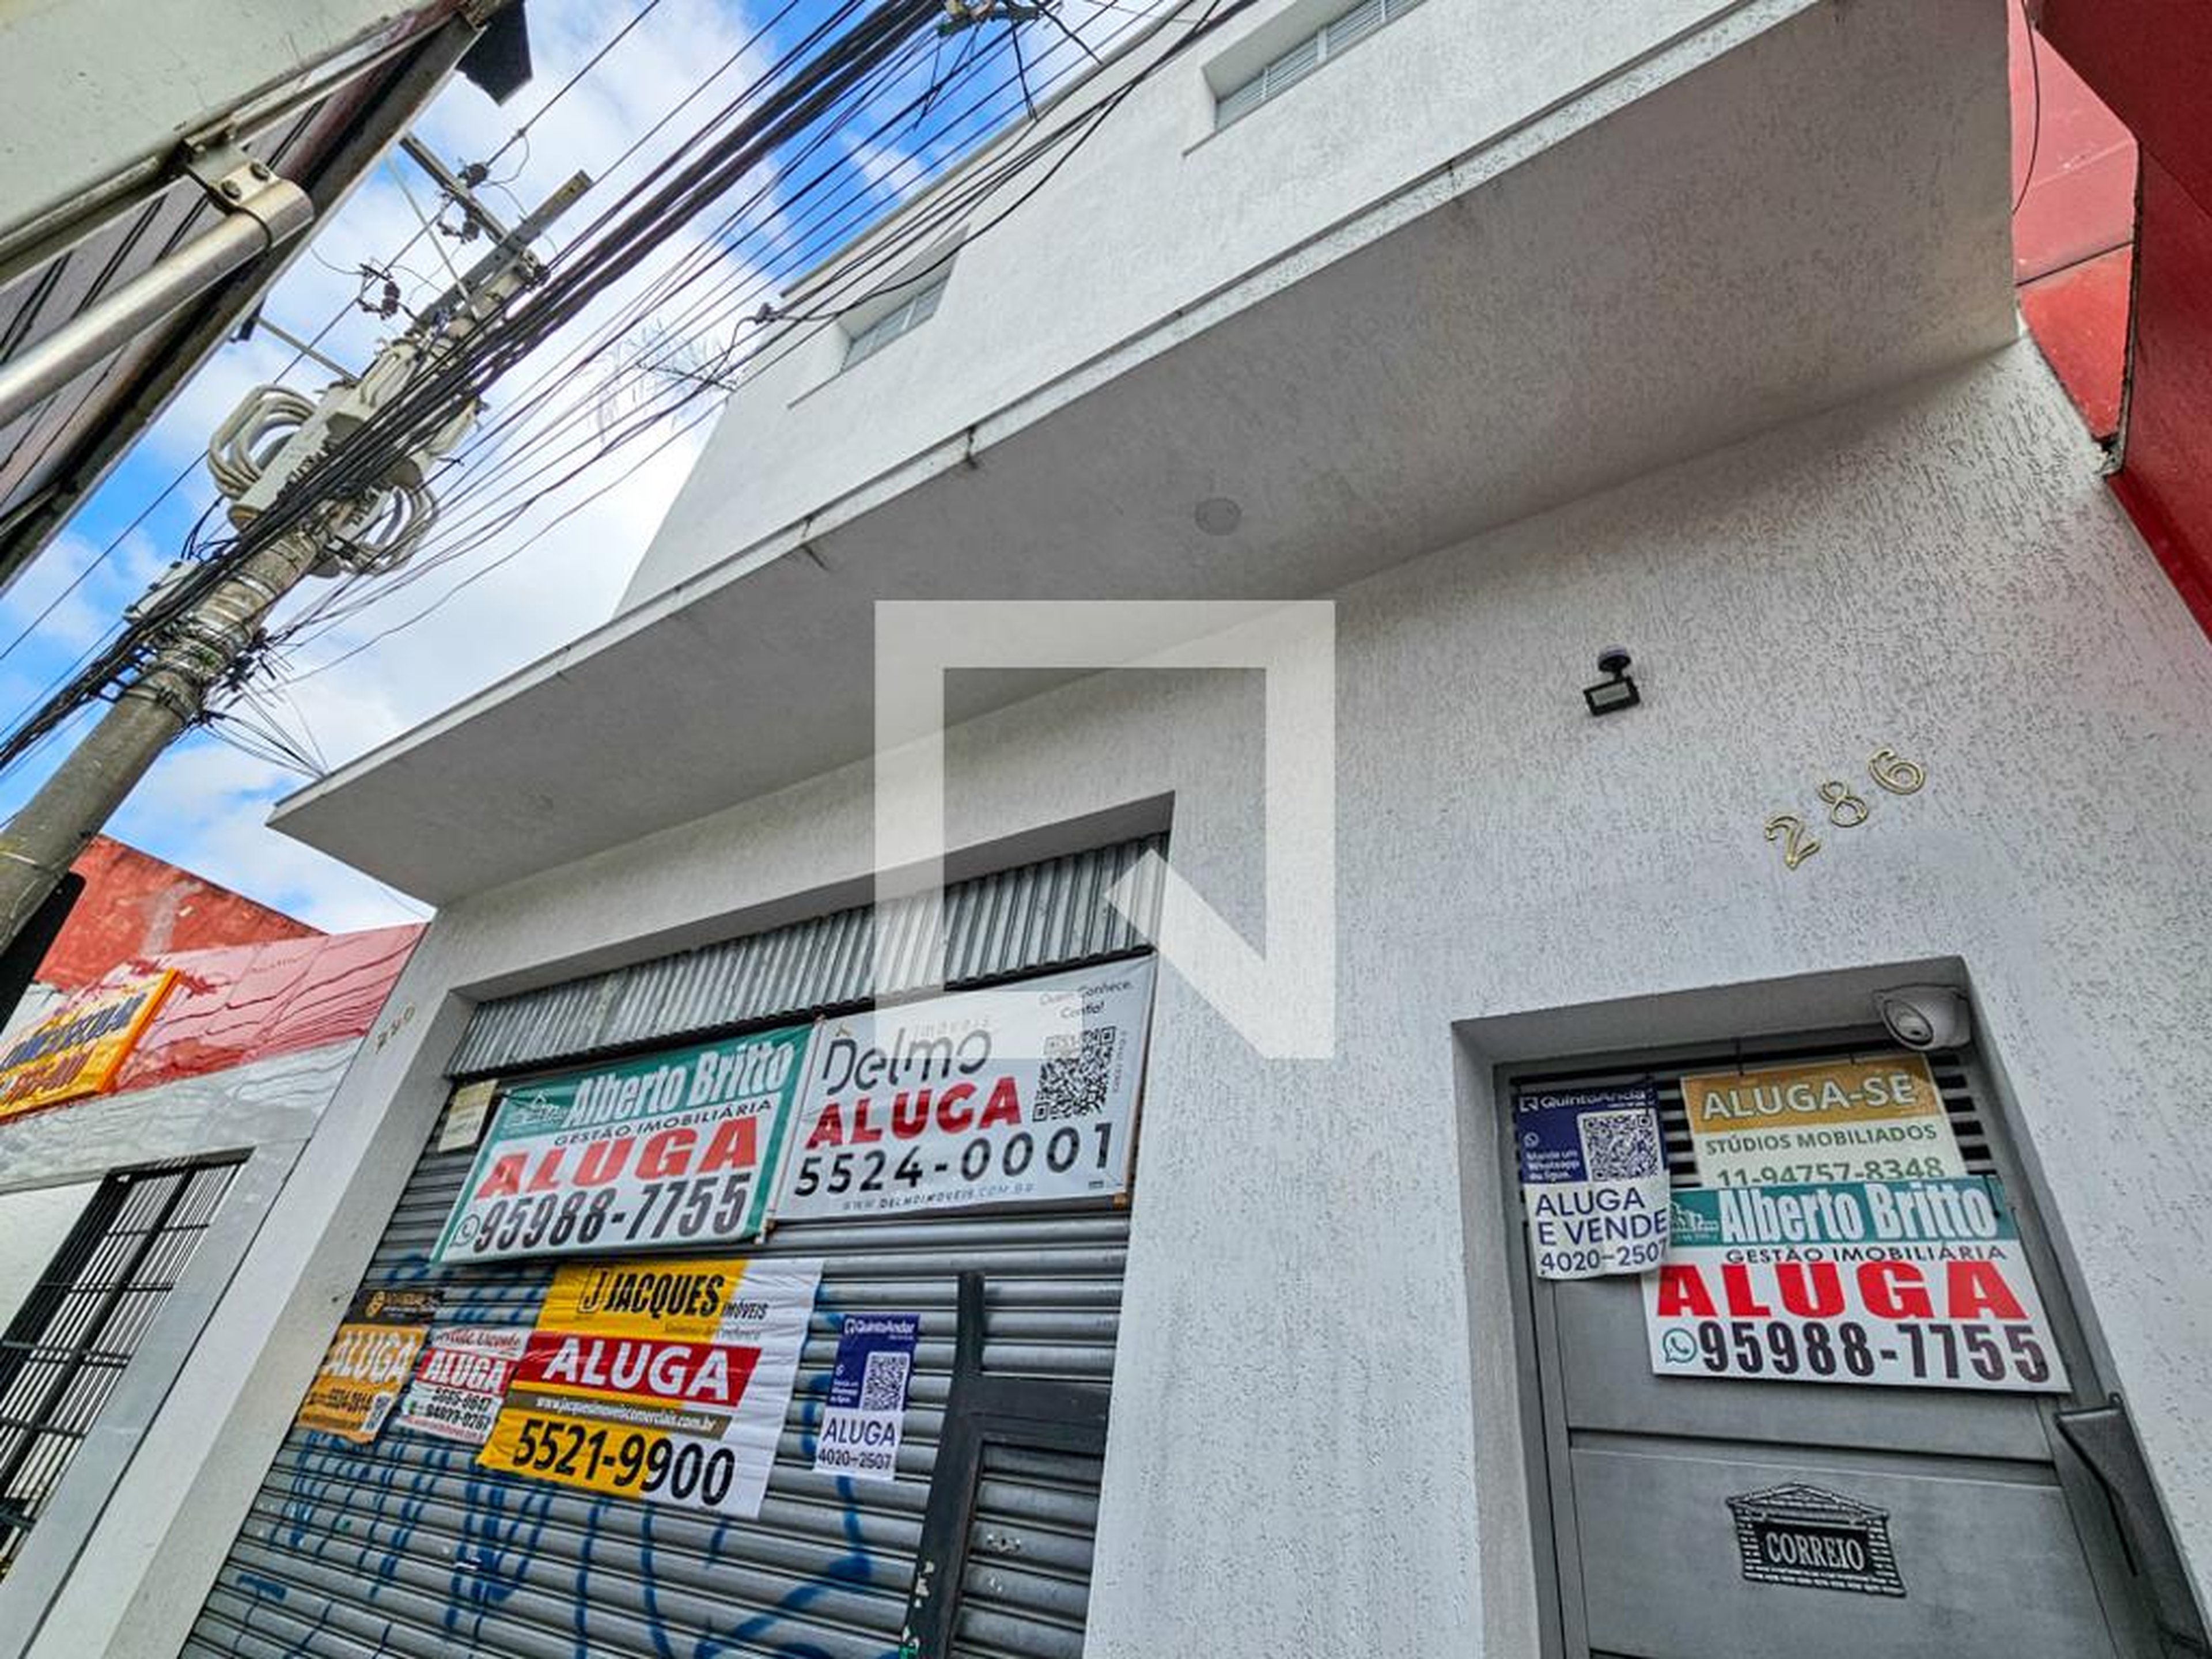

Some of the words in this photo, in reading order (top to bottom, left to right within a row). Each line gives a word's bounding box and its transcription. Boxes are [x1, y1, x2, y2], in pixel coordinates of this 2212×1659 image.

[1765, 747, 1926, 872] 286
[561, 1063, 687, 1128] Alberto
[690, 1041, 794, 1107] Britto
[822, 1027, 992, 1095] Delmo
[554, 1123, 631, 1146] GESTÃO
[633, 1098, 774, 1134] IMOBILIÁRIA
[806, 1077, 1021, 1150] ALUGA
[1703, 1073, 1916, 1120] ALUGA-SE
[474, 1117, 756, 1199] ALUGA
[794, 1122, 1112, 1196] 5524-0001
[1706, 1132, 1791, 1156] STÚDIOS
[1798, 1124, 1937, 1148] MOBILIADOS
[1717, 1157, 1945, 1187] 11-94757-8348
[473, 1173, 752, 1252] 95988-7755
[1536, 1188, 1645, 1216] ALUGA
[1539, 1222, 1557, 1246] E
[1564, 1209, 1667, 1245] VENDE
[1717, 1188, 1866, 1243] Alberto
[1863, 1181, 1999, 1238] Britto
[1541, 1239, 1667, 1271] 4020-2507
[1725, 1243, 1824, 1265] GESTÃO
[1833, 1240, 2009, 1262] IMOBILIÁRIA
[604, 1274, 726, 1318] JACQUES
[722, 1298, 768, 1320] IMÓVEIS
[1657, 1261, 2028, 1320] ALUGA
[321, 1329, 417, 1385] ALUGA
[422, 1351, 508, 1393] ALUGA
[541, 1338, 729, 1401] ALUGA
[1699, 1321, 2051, 1384] 95988-7755
[823, 1417, 895, 1447] ALUGA
[513, 1419, 735, 1505] 5521-9900
[818, 1448, 892, 1470] 4020-2507
[1766, 1532, 1865, 1571] CORREIO
